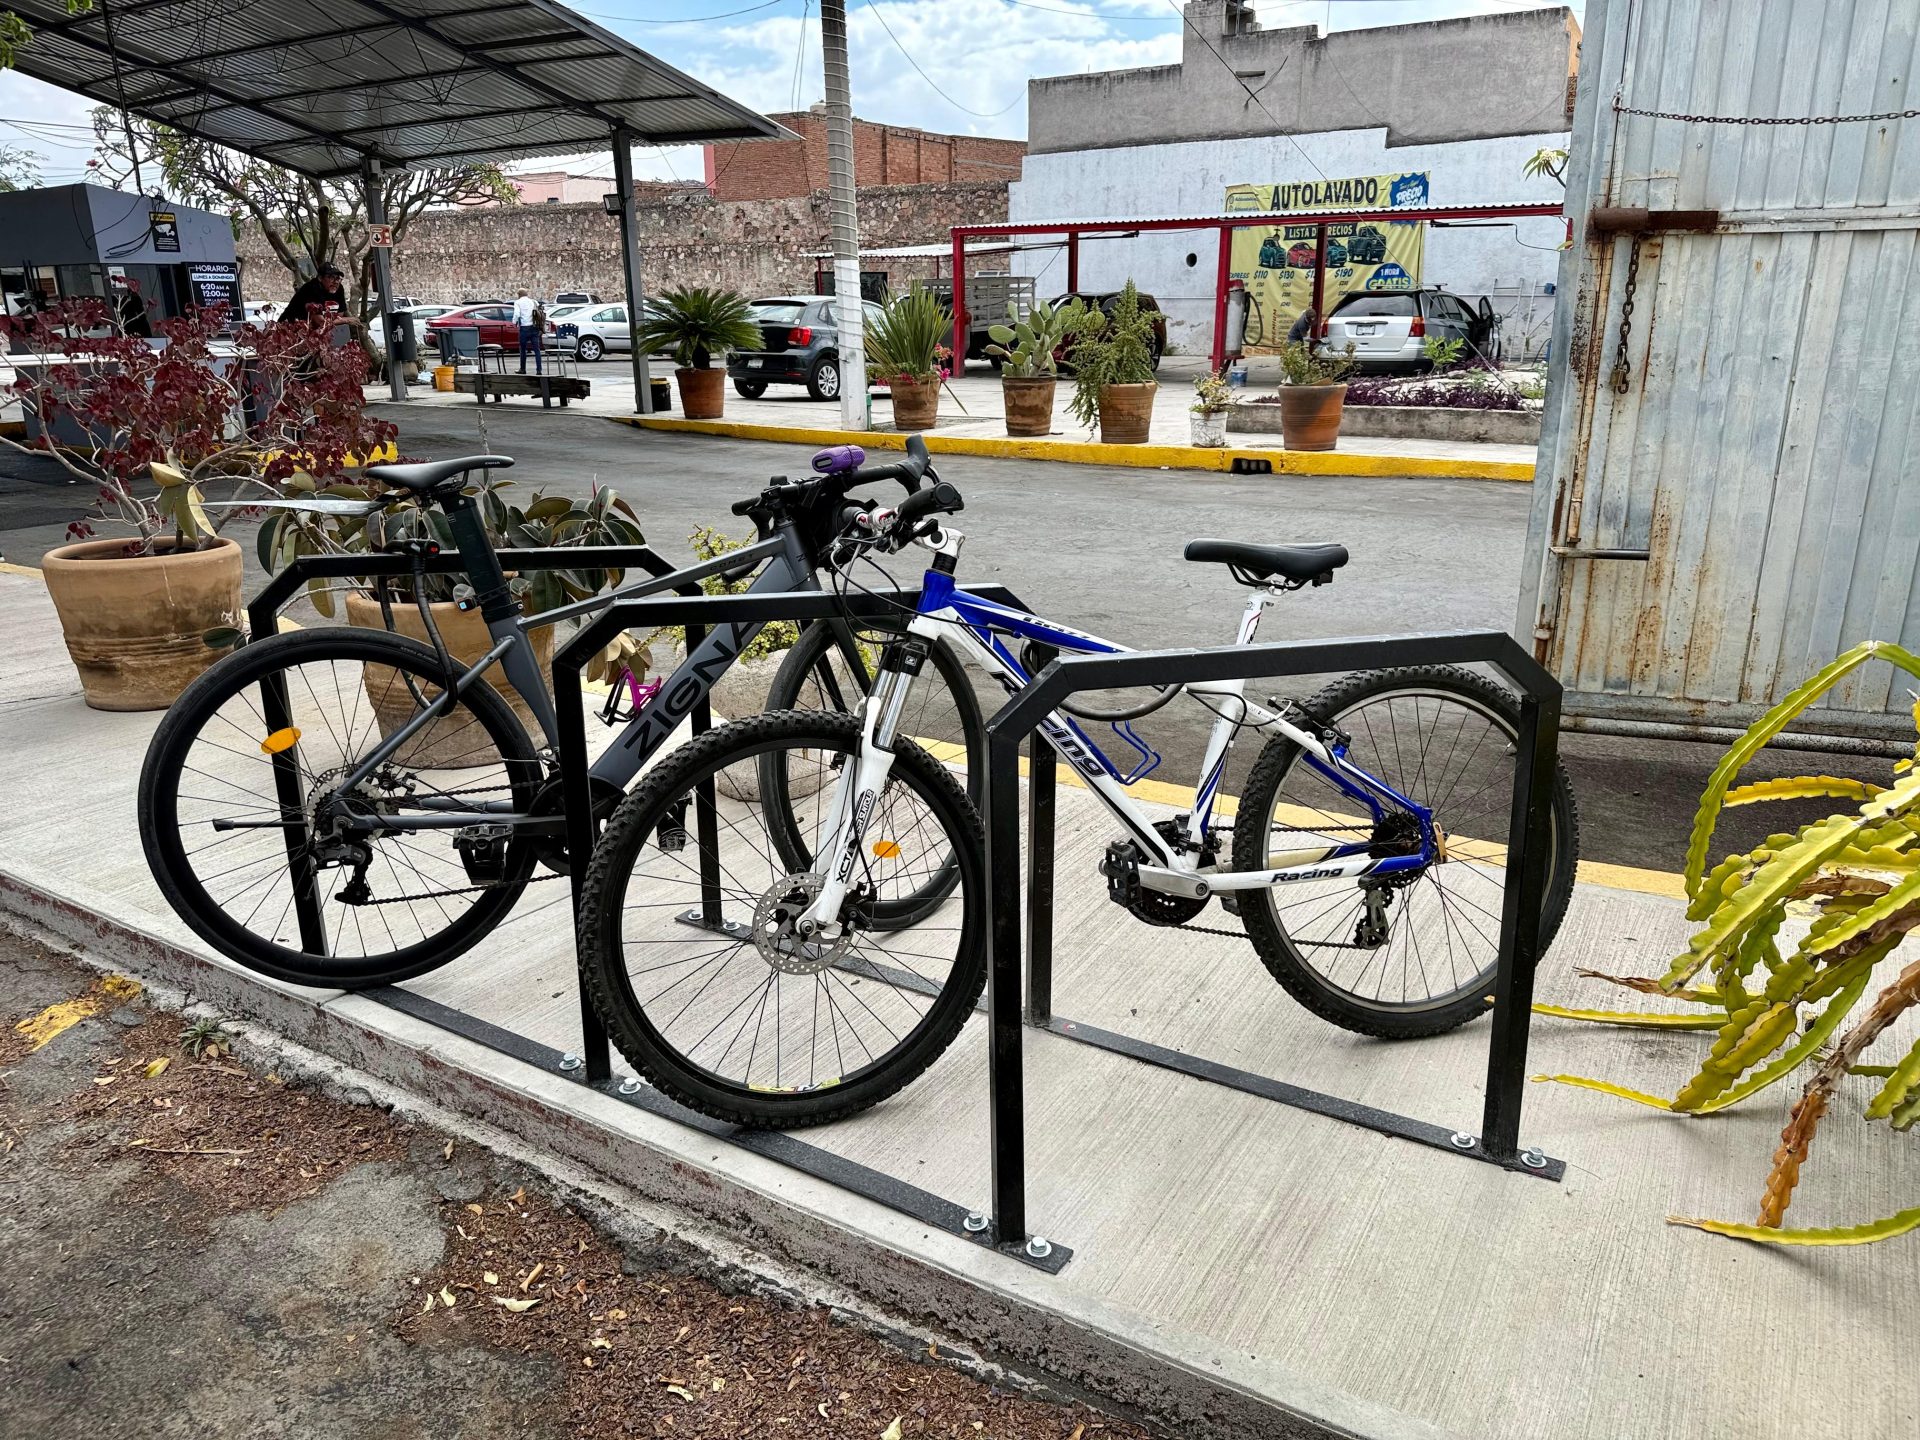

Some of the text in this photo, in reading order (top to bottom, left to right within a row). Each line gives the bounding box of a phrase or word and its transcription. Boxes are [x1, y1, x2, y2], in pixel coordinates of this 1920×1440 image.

[1271, 177, 1378, 211] AUTOLAVADO
[1396, 185, 1423, 204] PRECIO
[1289, 228, 1309, 239] LISTA
[1327, 225, 1352, 236] RECIOS
[195, 264, 229, 272] HORARIO
[1254, 270, 1269, 279] $110
[1279, 270, 1295, 280] $130
[1334, 268, 1353, 278] $190
[1380, 268, 1384, 276] 1
[1369, 276, 1409, 290] GRATIS
[1270, 867, 1344, 883] Racing
